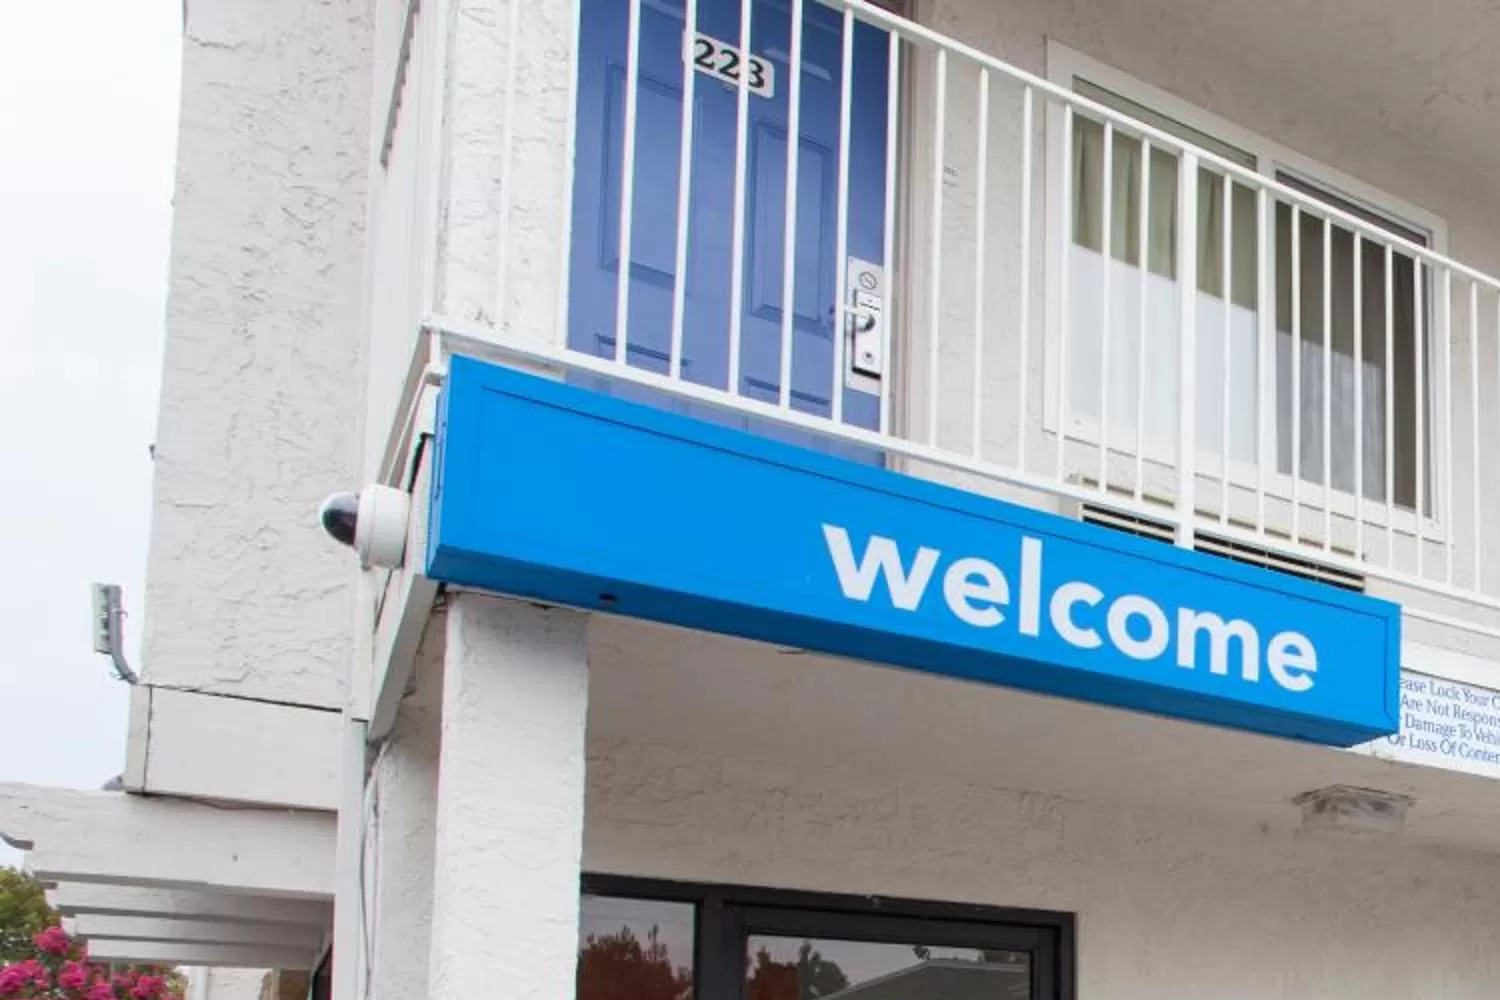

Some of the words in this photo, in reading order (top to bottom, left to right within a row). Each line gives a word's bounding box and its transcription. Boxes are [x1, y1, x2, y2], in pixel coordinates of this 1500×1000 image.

[694, 38, 765, 88] 223
[821, 523, 1318, 692] welcome
[1399, 679, 1427, 693] ease
[1430, 679, 1460, 701] Lock
[1459, 687, 1490, 706] Your
[1401, 692, 1424, 712] Are
[1426, 699, 1451, 717] Not
[1405, 712, 1457, 739] Damage
[1458, 723, 1473, 740] To
[1409, 732, 1437, 752] Loss
[1440, 738, 1457, 757] Of
